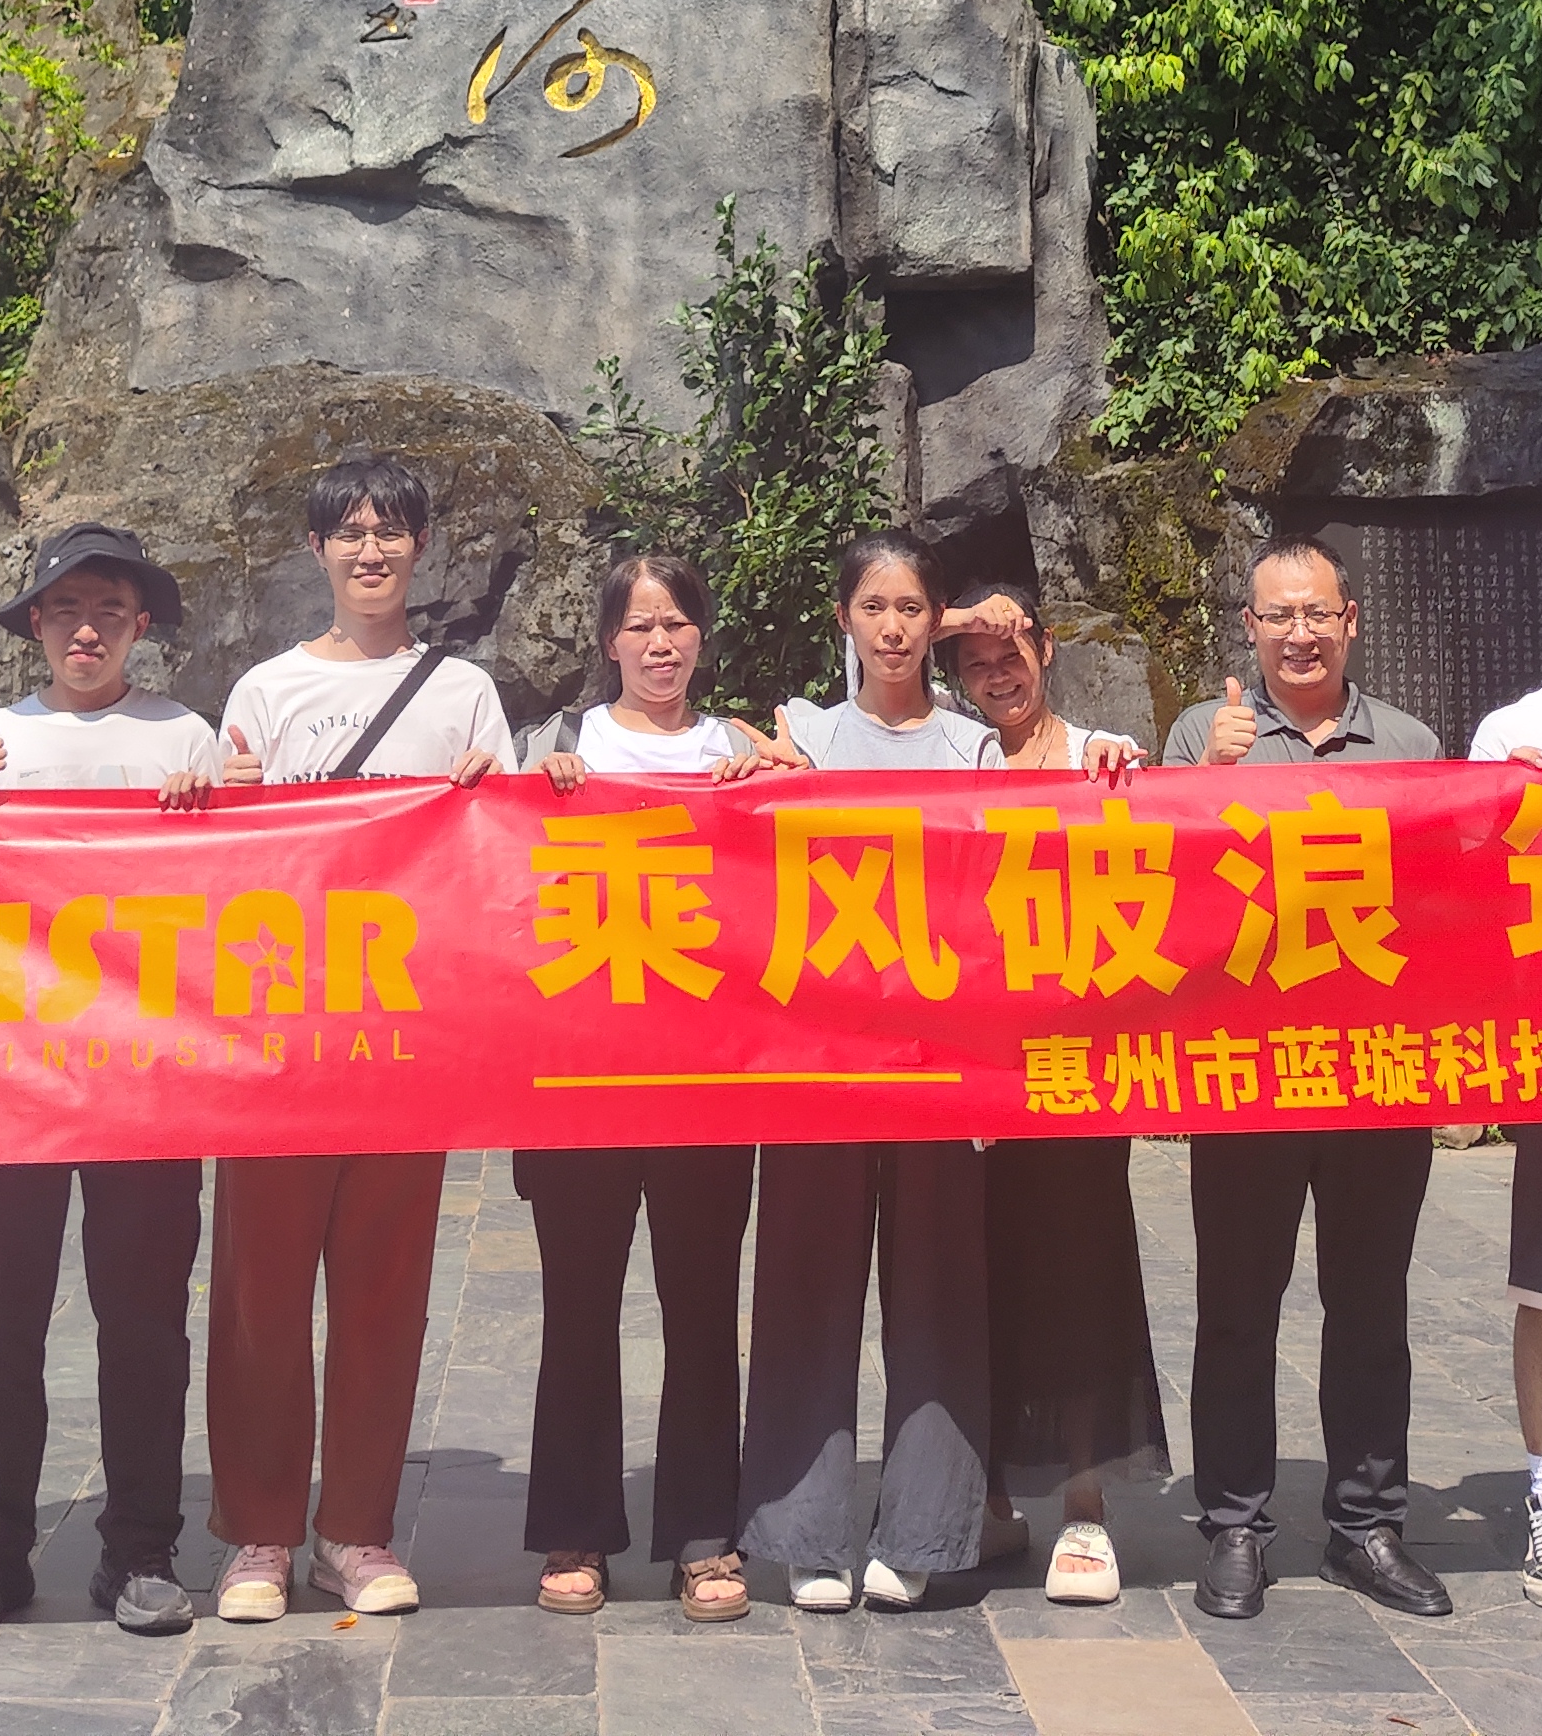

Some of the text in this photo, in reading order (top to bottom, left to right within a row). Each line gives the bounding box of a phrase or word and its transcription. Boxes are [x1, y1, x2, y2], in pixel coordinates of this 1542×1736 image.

[527, 790, 1408, 1005] 乘风破浪
[5, 1029, 415, 1071] INDUSTRIAL
